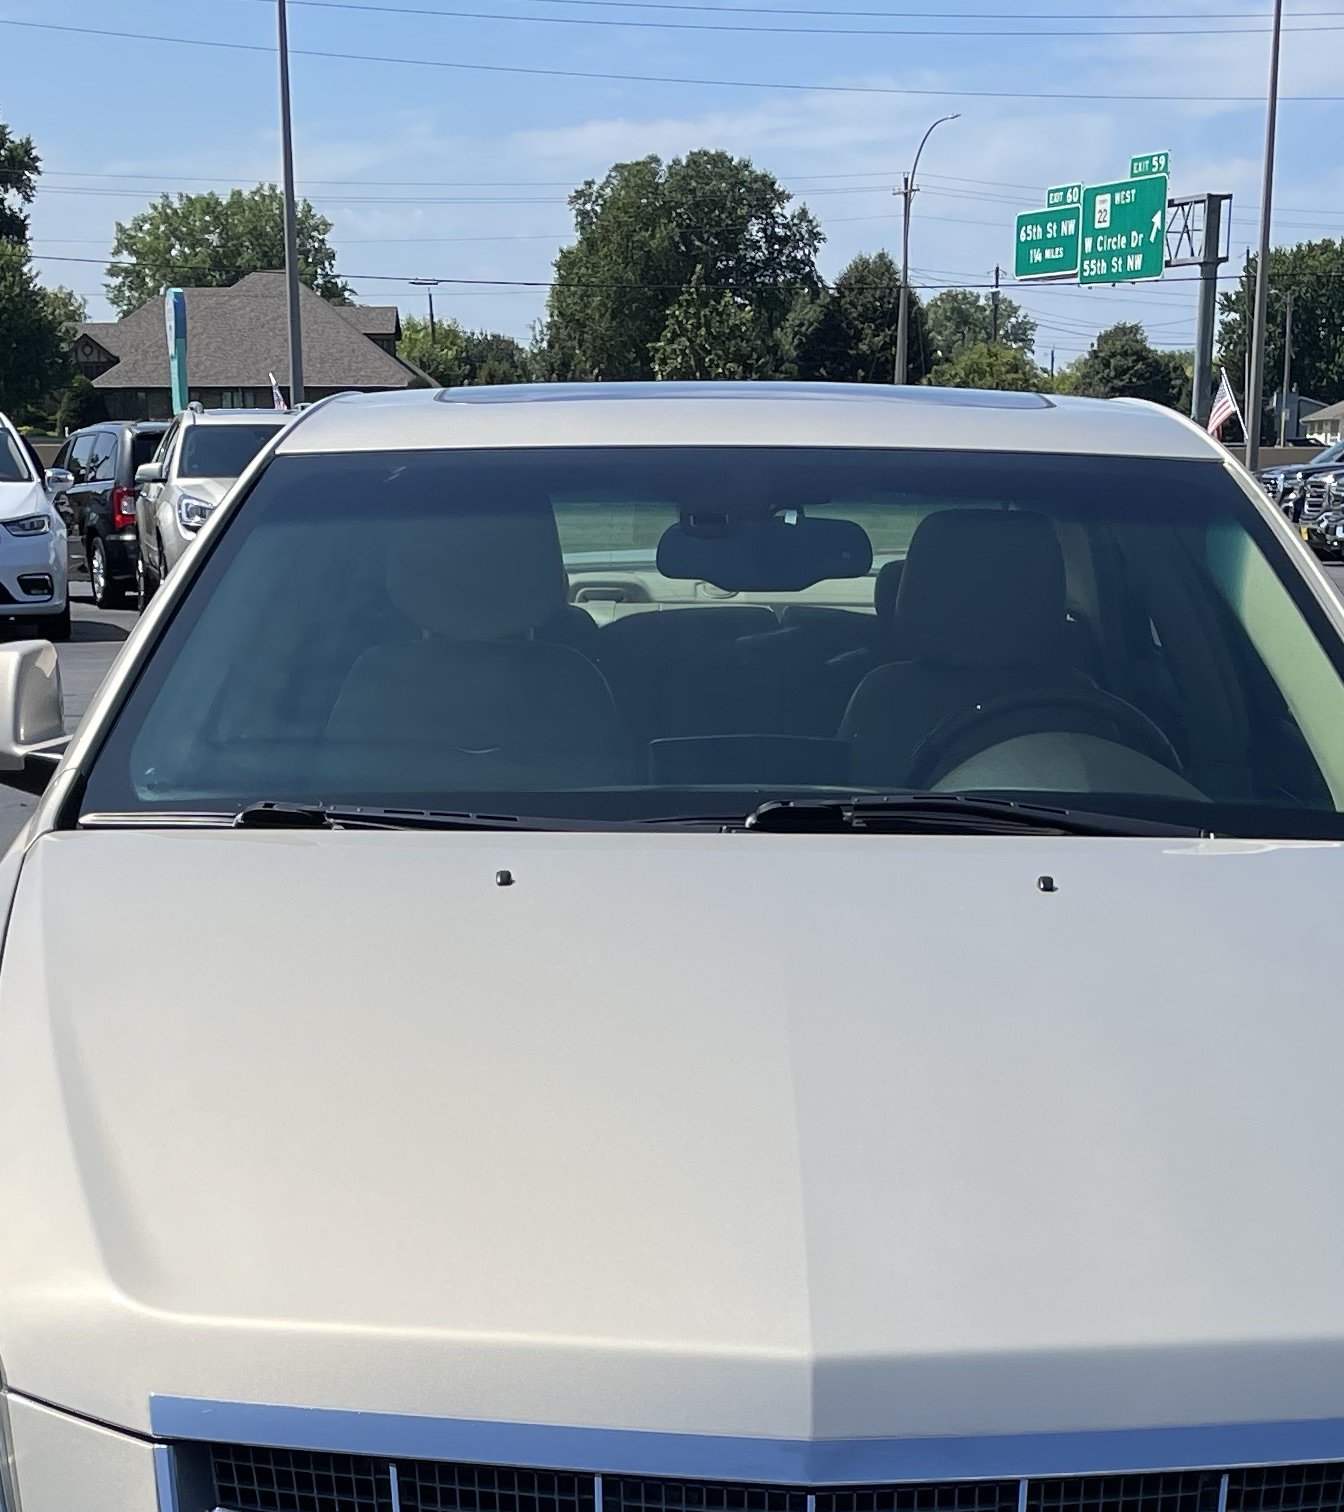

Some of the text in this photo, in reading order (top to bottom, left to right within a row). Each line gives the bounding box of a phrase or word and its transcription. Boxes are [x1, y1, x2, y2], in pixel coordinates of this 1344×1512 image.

[1133, 155, 1166, 174] EXIT 59
[1049, 186, 1079, 204] EXIT 60
[1114, 188, 1136, 205] WEST
[1097, 208, 1108, 224] 22
[1019, 219, 1076, 242] 65th St NW
[1084, 230, 1144, 254] W Circle Dr
[1044, 246, 1064, 260] MILES
[1082, 253, 1143, 277] 55th St NW
